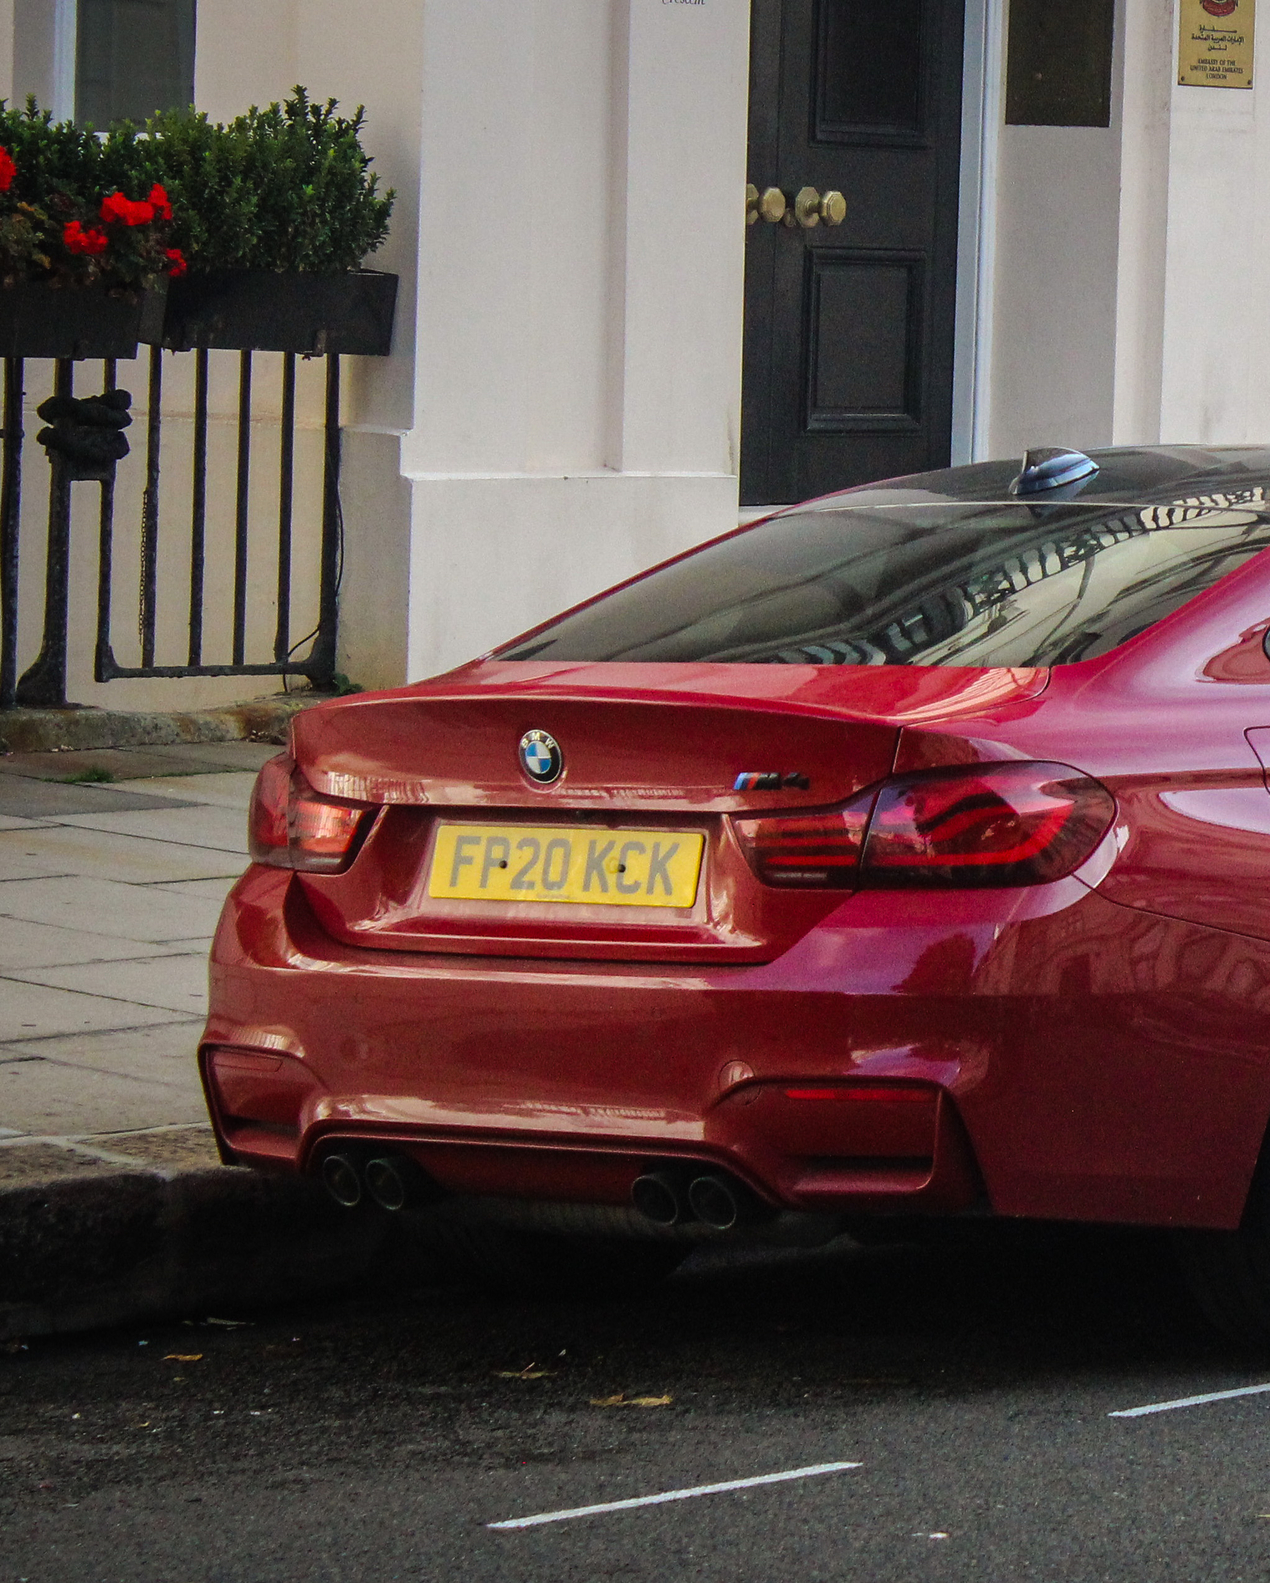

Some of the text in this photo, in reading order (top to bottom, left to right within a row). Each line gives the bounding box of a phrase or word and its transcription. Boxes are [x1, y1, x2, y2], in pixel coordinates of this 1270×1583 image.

[521, 731, 555, 749] BMW
[735, 771, 810, 791] M4
[449, 835, 681, 897] FP20 KCK
